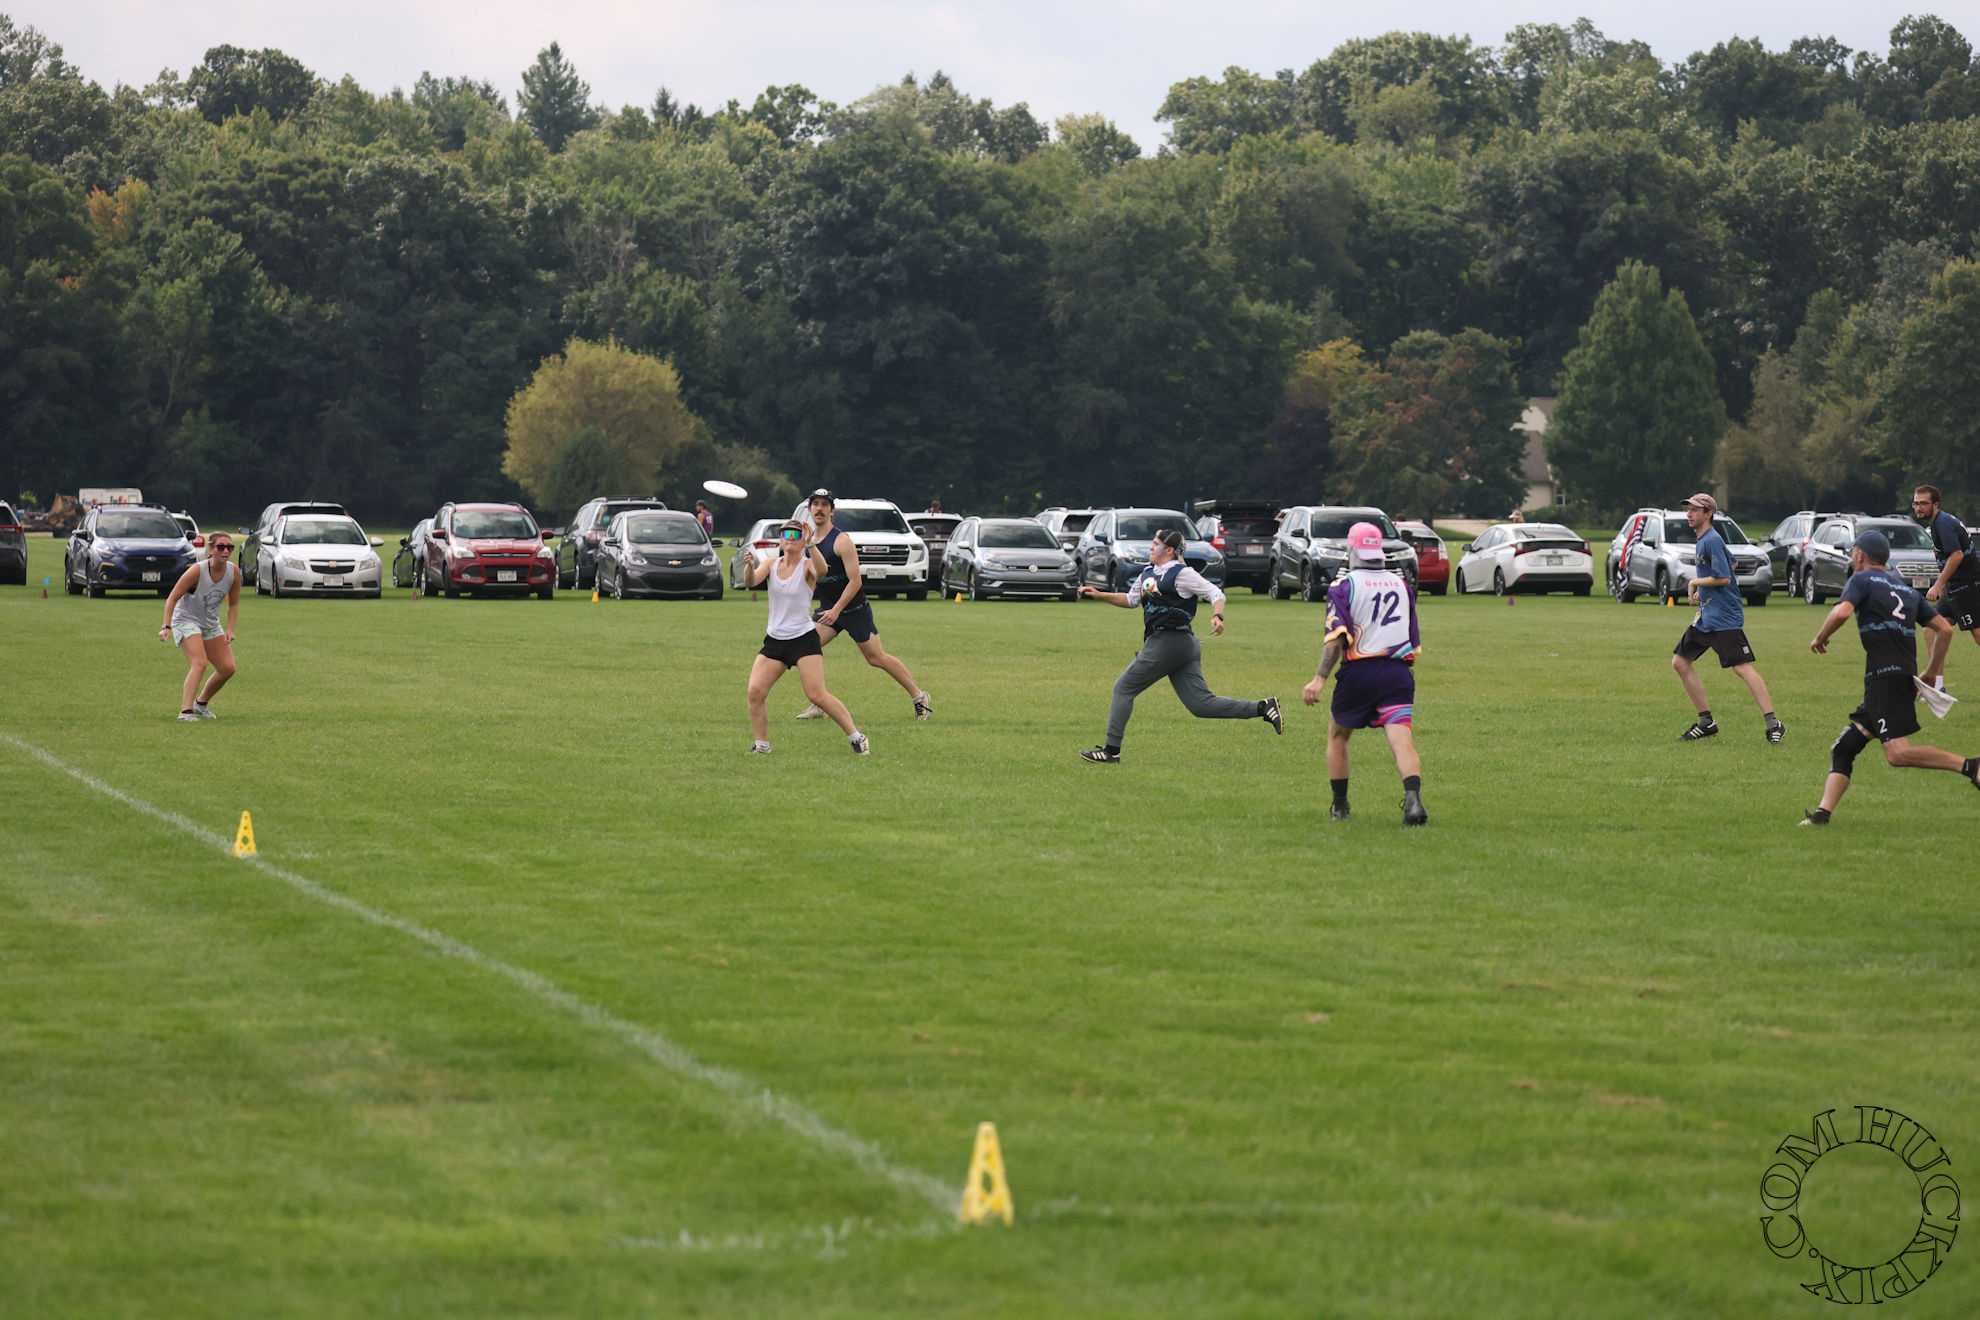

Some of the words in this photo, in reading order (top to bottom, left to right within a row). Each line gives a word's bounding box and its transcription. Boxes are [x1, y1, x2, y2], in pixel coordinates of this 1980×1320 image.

[1370, 590, 1404, 627] 12
[1889, 591, 1906, 620] 2
[1960, 614, 1973, 626] 13
[1877, 718, 1888, 734] 2
